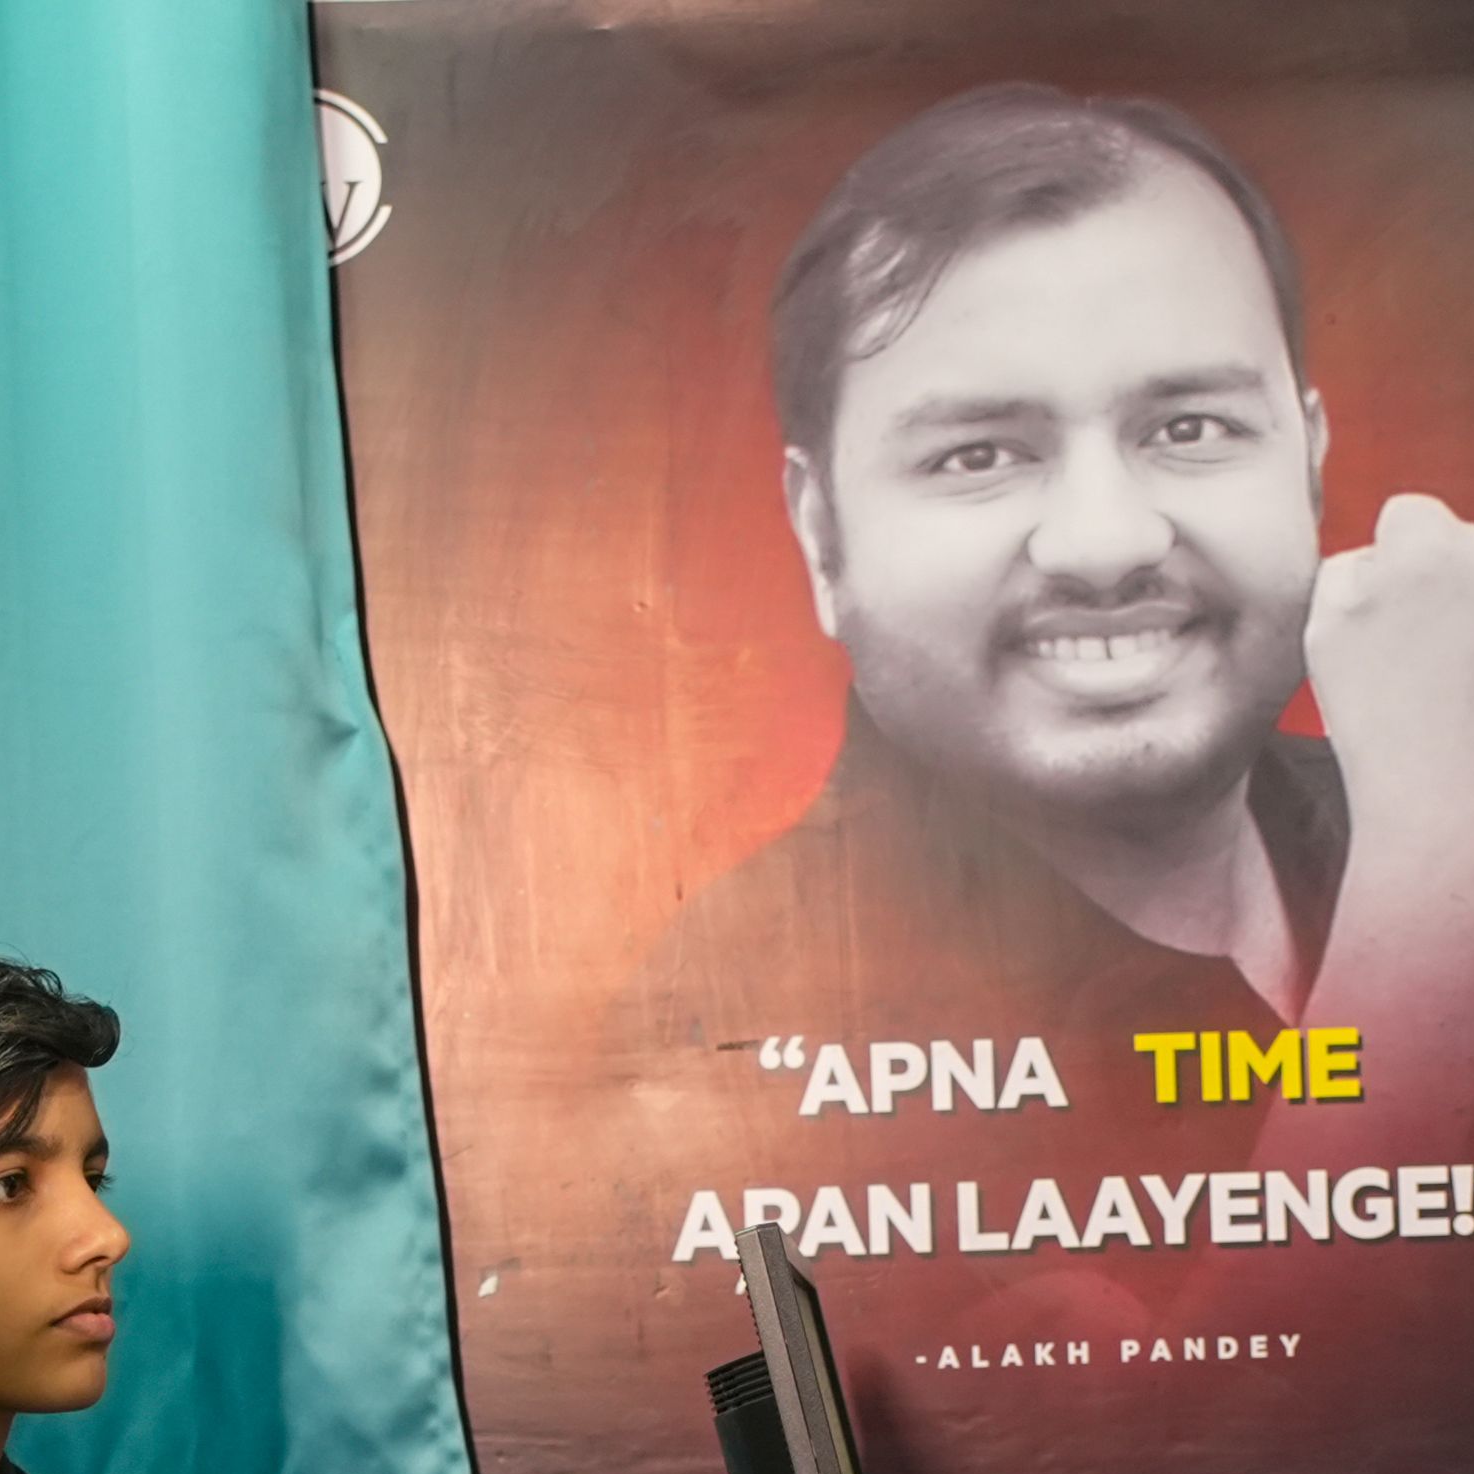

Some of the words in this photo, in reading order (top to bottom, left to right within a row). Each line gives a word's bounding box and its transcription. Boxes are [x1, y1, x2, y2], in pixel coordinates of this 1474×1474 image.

[1133, 1027, 1362, 1104] TIME
[672, 1183, 932, 1262] APAN
[1120, 1334, 1302, 1363] PANDEY
